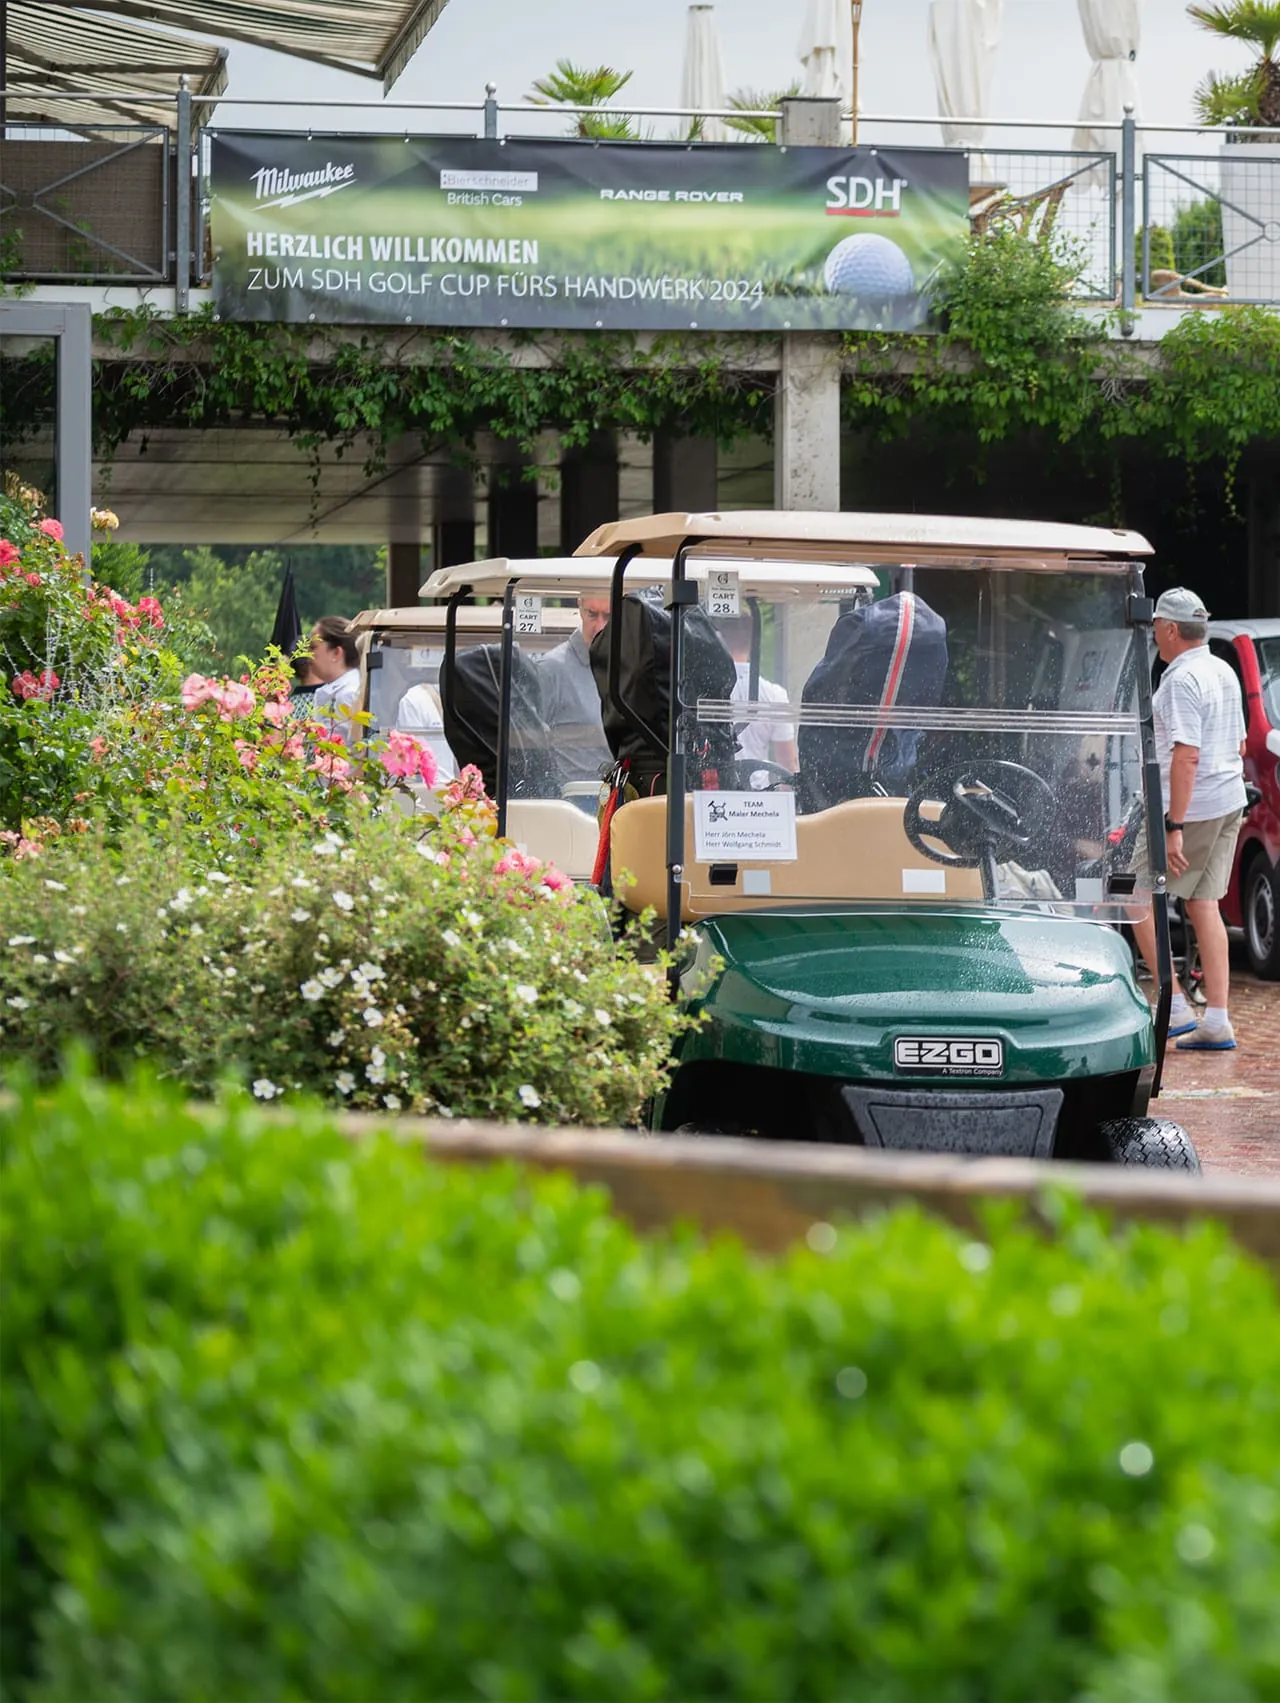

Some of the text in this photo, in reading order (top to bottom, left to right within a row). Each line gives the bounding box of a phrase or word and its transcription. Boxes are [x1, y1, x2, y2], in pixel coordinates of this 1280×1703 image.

[249, 162, 354, 199] Milwaukee
[447, 192, 523, 206] British Cars
[600, 189, 744, 203] RANGE ROVER
[247, 232, 539, 264] HERZLICH WILLKOMMEN
[248, 268, 764, 303] ZUM SDH GOLF CUP FÜRS HANDWERK 2024
[712, 592, 736, 600] CART
[974, 1068, 1003, 1076] Company
